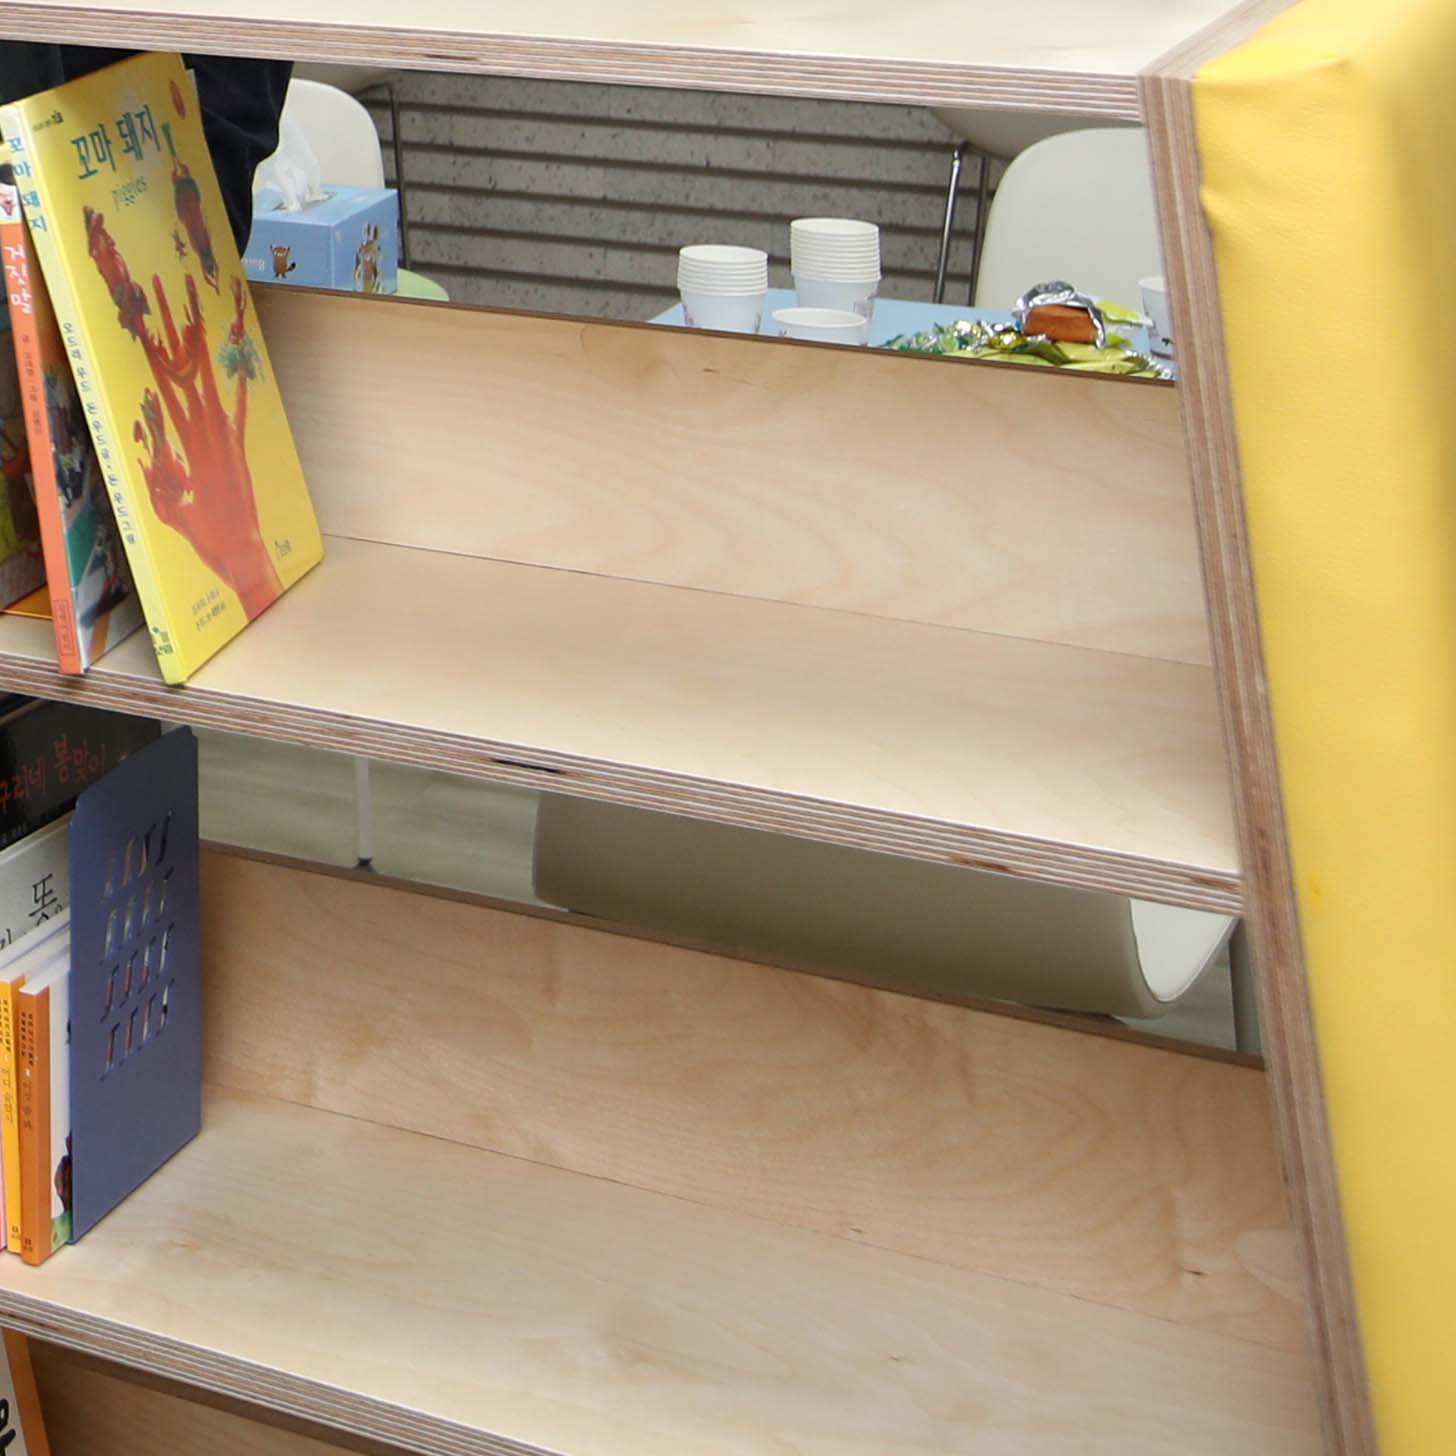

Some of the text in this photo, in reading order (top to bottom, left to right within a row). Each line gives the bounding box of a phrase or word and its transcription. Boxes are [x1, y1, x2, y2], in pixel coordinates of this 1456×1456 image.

[71, 122, 117, 181] 꼬마
[115, 103, 162, 162] 돼지
[7, 137, 48, 232] 꼬마 돼지
[2, 243, 33, 314] 거짓말
[53, 732, 107, 785] 봄맞이
